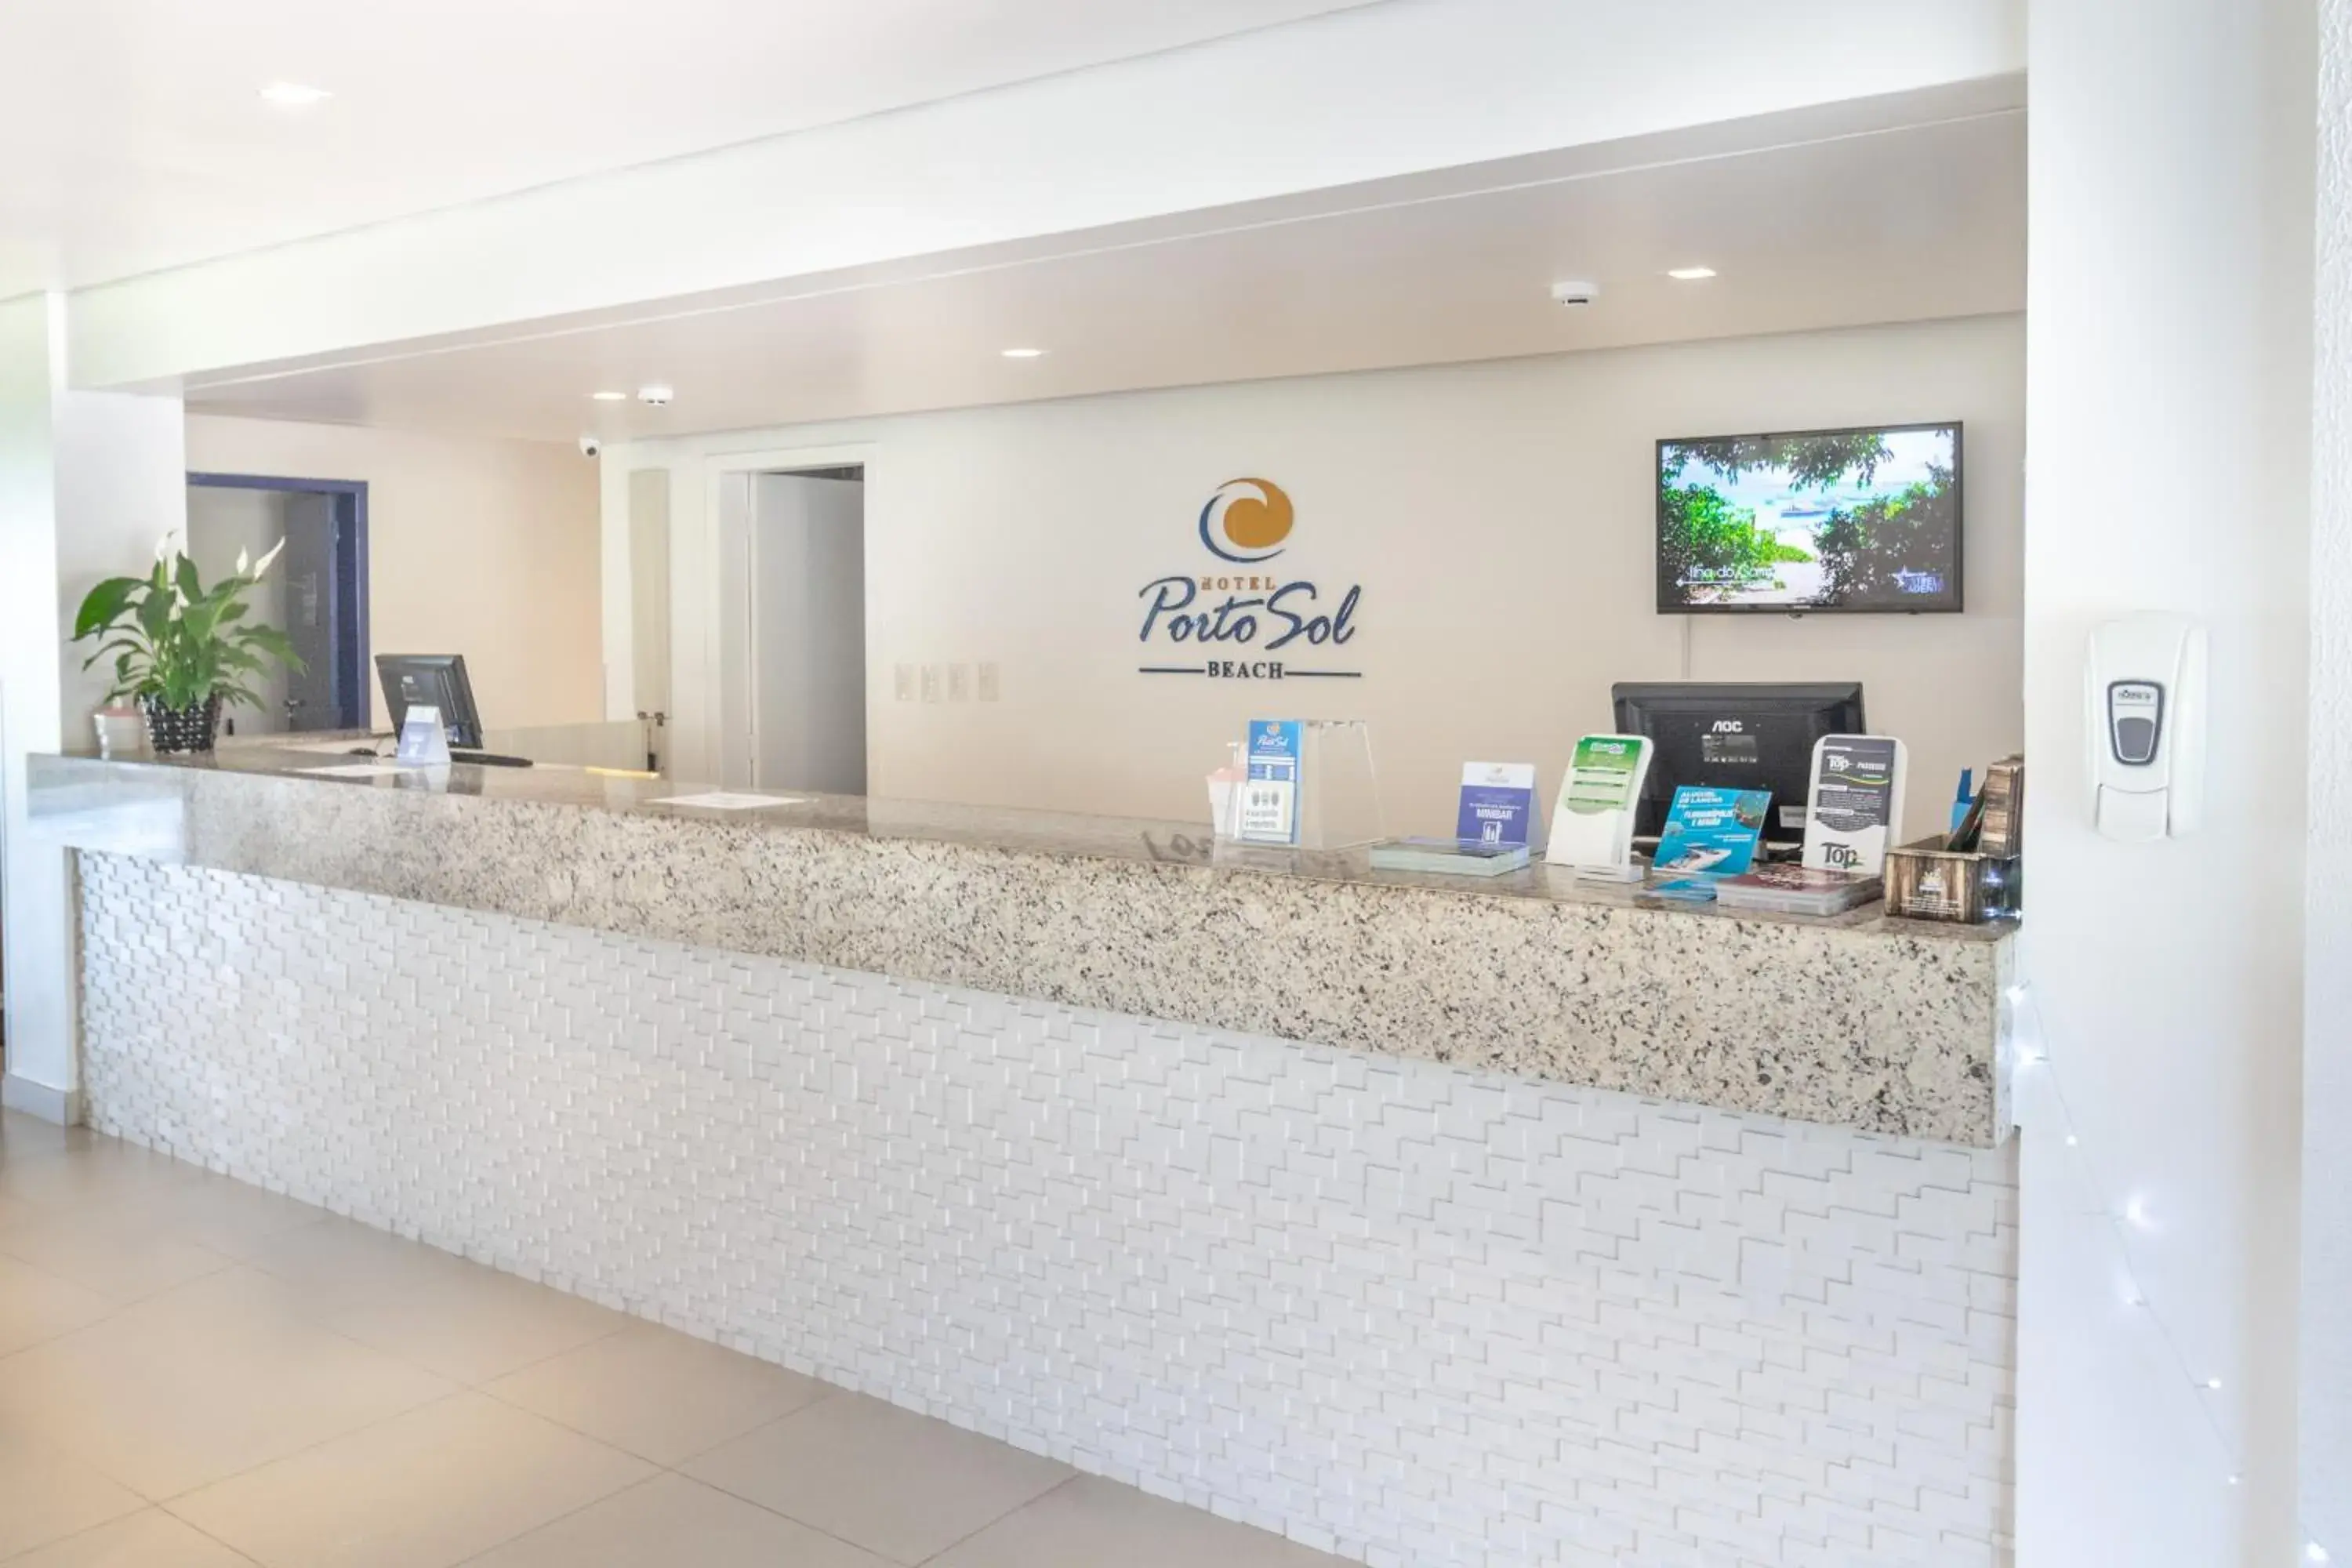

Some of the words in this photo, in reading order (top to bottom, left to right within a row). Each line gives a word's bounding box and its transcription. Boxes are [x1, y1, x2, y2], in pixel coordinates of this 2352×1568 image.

[1200, 577, 1276, 590] HOTEL
[1139, 576, 1264, 643] Porto
[1265, 581, 1362, 650] Sol
[1206, 661, 1284, 679] BEACH
[1711, 720, 1744, 732] AOC
[1820, 842, 1857, 869] Top
